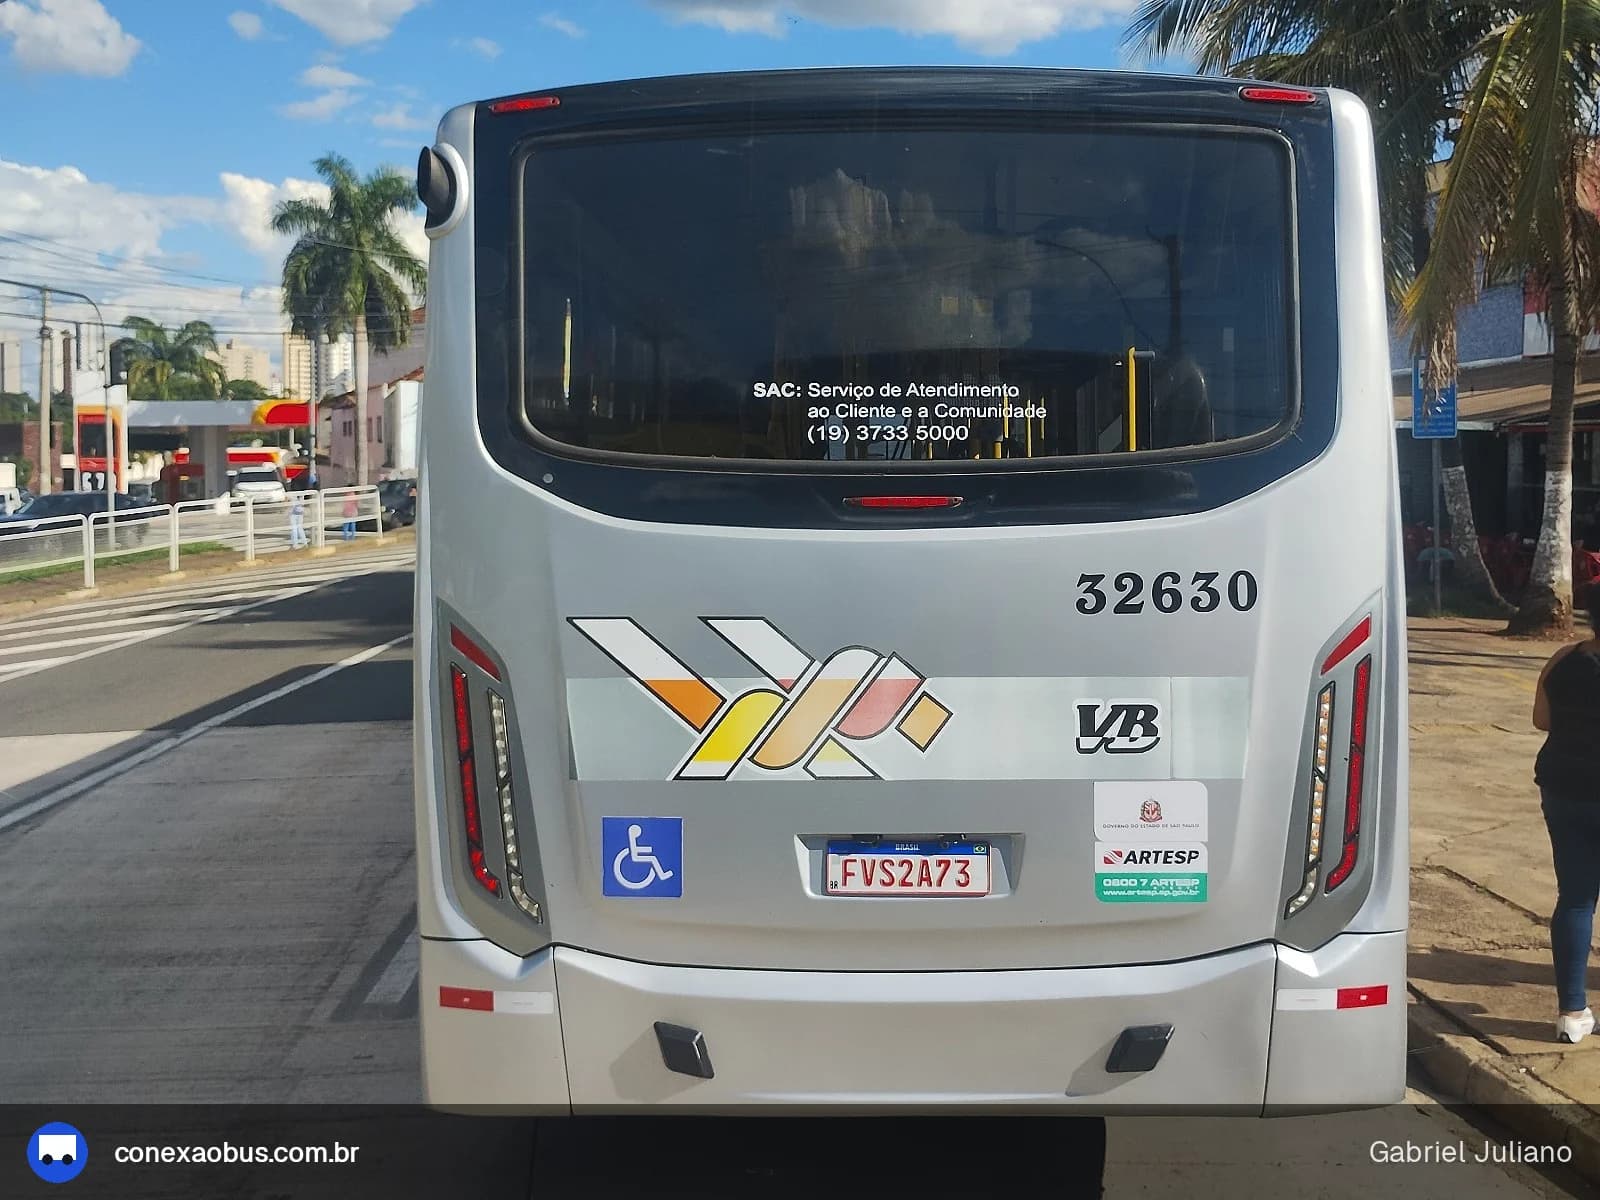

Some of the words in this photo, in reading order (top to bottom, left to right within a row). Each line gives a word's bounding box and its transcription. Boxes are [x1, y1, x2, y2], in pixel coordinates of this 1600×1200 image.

[753, 382, 802, 398] SAC:
[807, 382, 875, 401] Serviço
[879, 382, 902, 397] de
[905, 382, 1020, 398] Atendimento
[807, 405, 831, 419] ao
[835, 403, 896, 418] Cliente
[901, 406, 913, 418] e
[917, 406, 929, 418] a
[934, 403, 1047, 419] Comunidade
[807, 424, 850, 444] (19)
[856, 425, 909, 441] 3733
[916, 425, 969, 441] 5000
[1075, 570, 1258, 615] 32630
[1075, 704, 1161, 754] VB
[895, 843, 921, 851] BRASIL
[1123, 850, 1200, 865] ARTESP
[842, 858, 970, 887] FVS2A73
[830, 880, 839, 890] BR
[1103, 878, 1137, 887] 0800
[1140, 878, 1148, 887] 7
[1150, 878, 1200, 887] ARTESP
[1102, 889, 1200, 897] www.artesp.sp.gov.br
